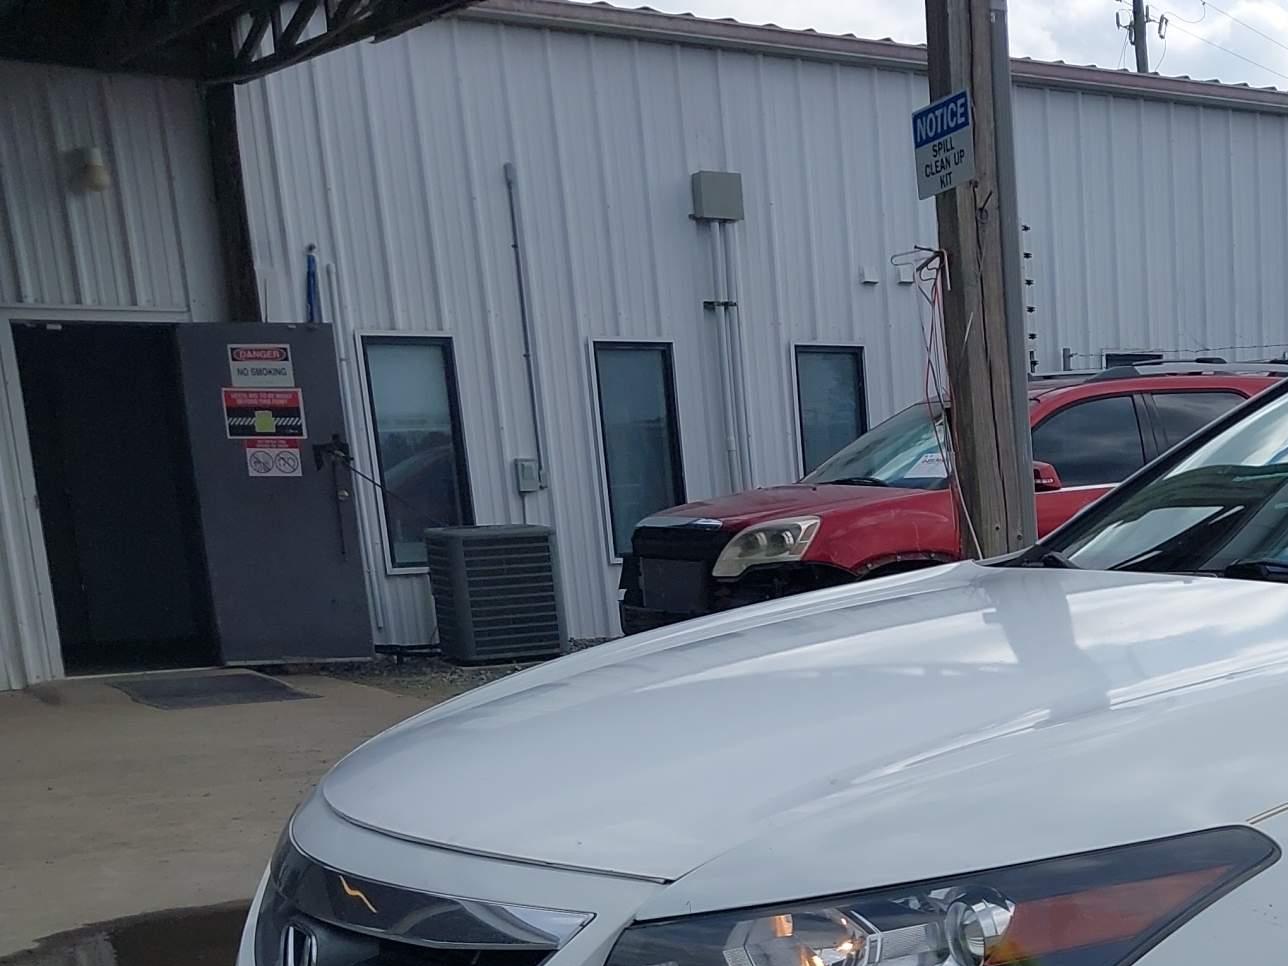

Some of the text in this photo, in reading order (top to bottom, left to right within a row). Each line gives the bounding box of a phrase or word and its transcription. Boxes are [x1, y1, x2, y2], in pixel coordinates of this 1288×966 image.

[916, 97, 966, 143] NOTICE
[931, 135, 955, 158] SPILL
[924, 149, 965, 178] CLEAN UP
[940, 172, 953, 189] KIT
[239, 350, 280, 359] DANGER
[237, 367, 288, 377] NO SMOKING
